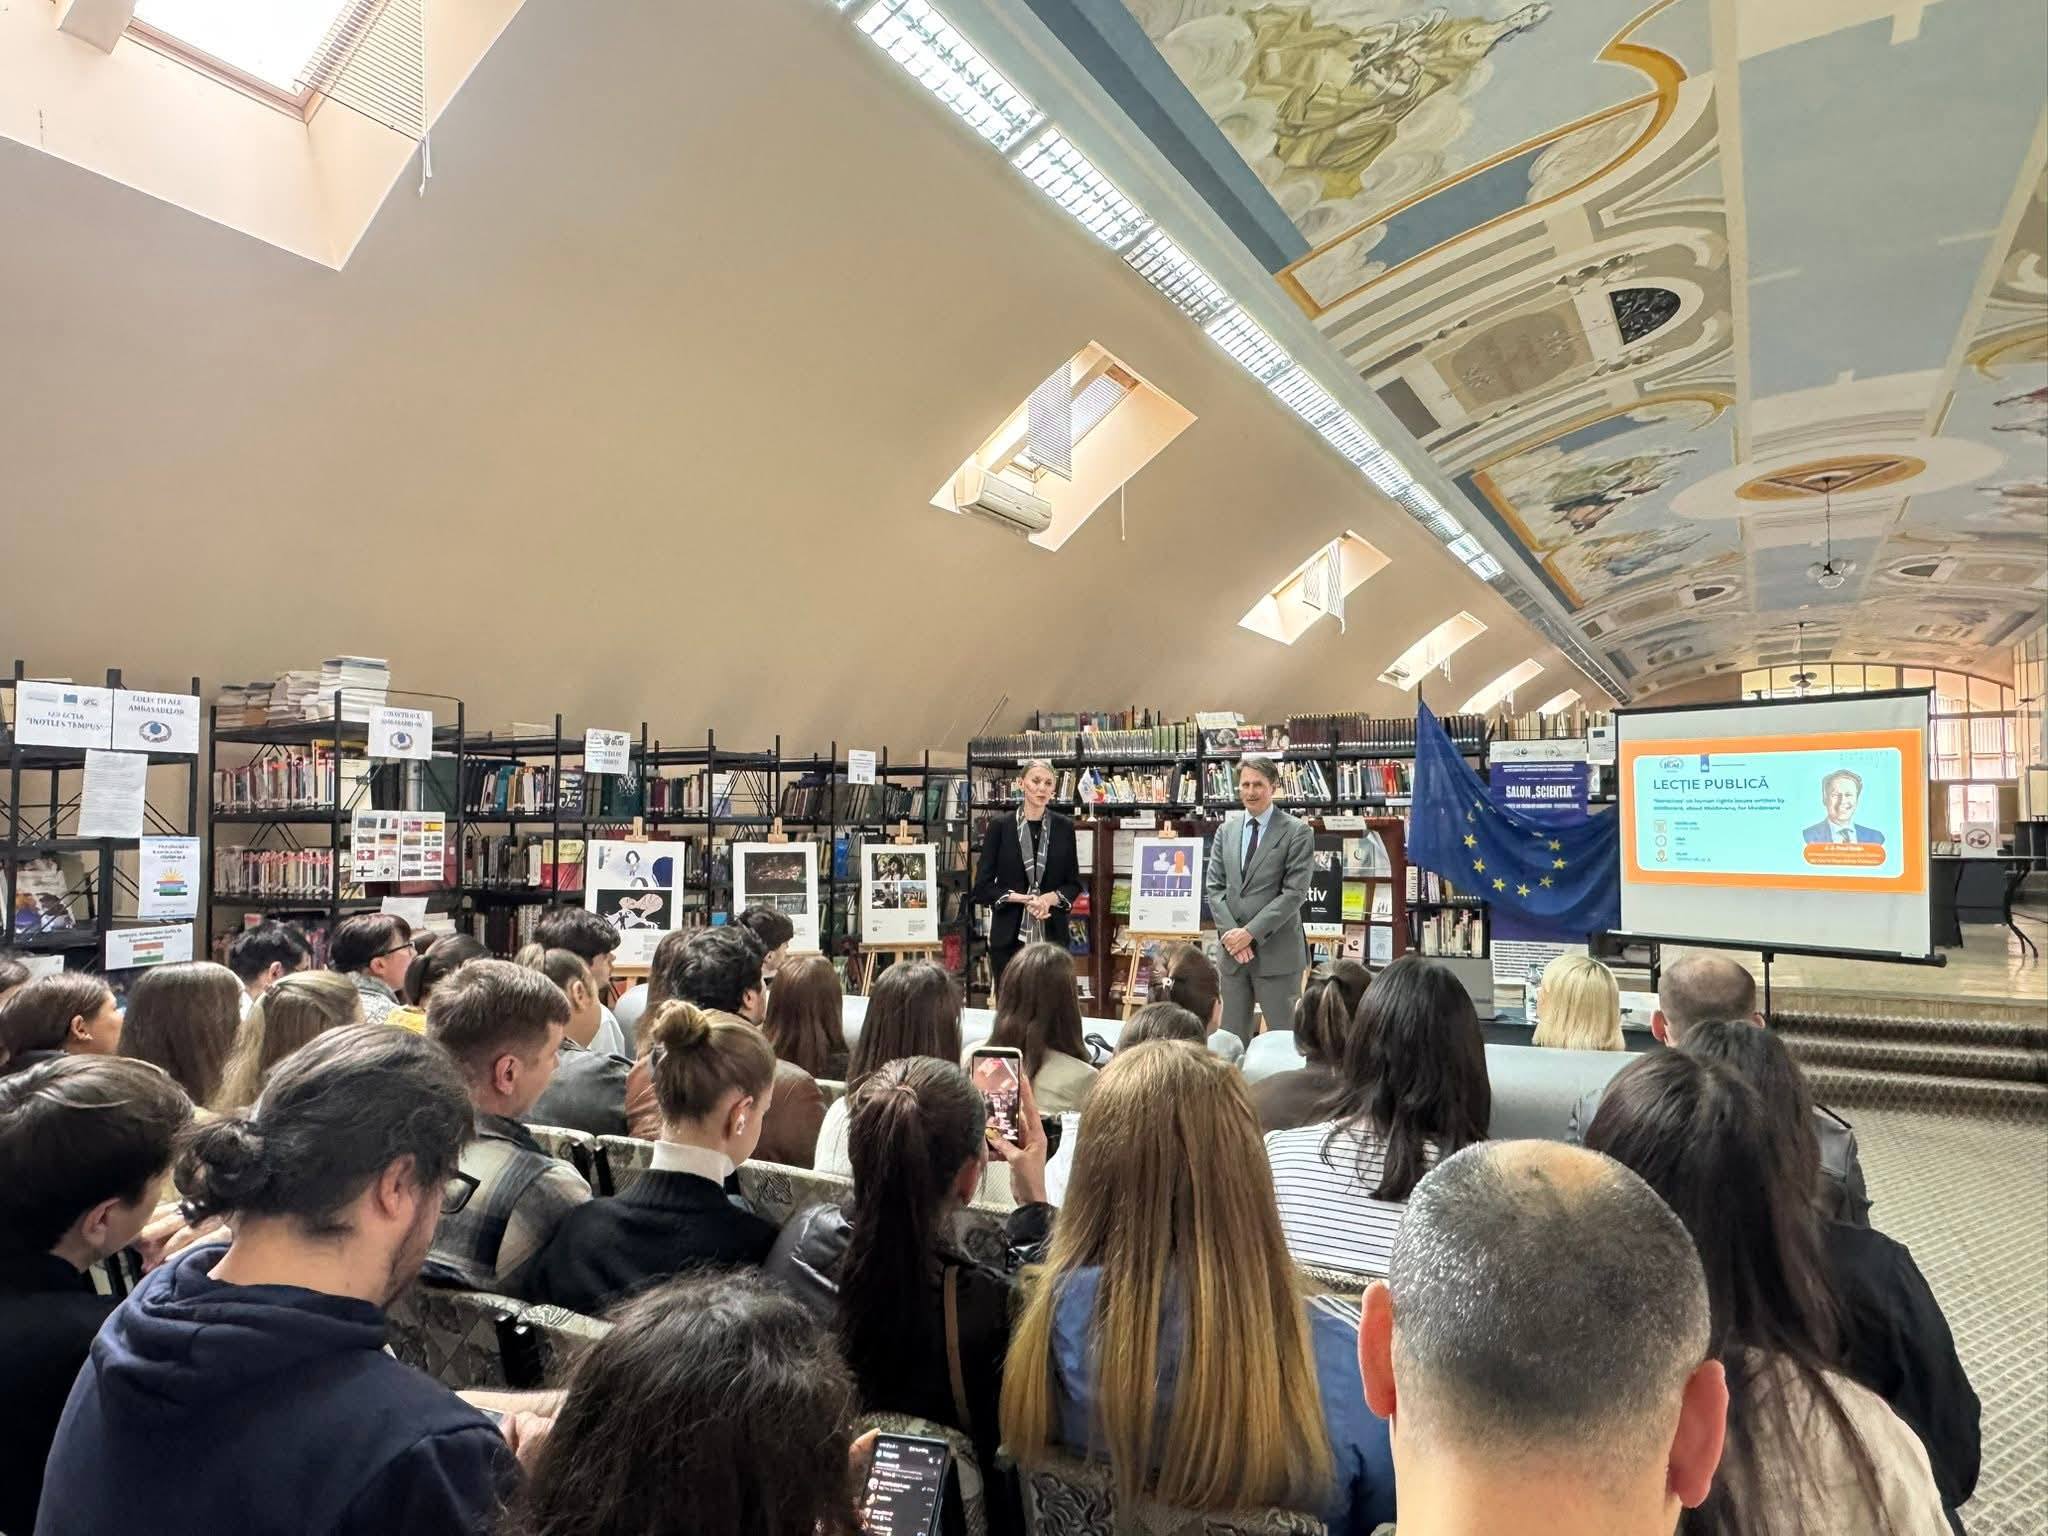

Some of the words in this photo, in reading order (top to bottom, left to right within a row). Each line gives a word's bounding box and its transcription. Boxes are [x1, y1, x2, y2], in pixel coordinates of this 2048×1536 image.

[1704, 776, 1769, 789] PUBLICĂ
[1505, 785, 1531, 798] SALON
[1305, 887, 1328, 902] tiv
